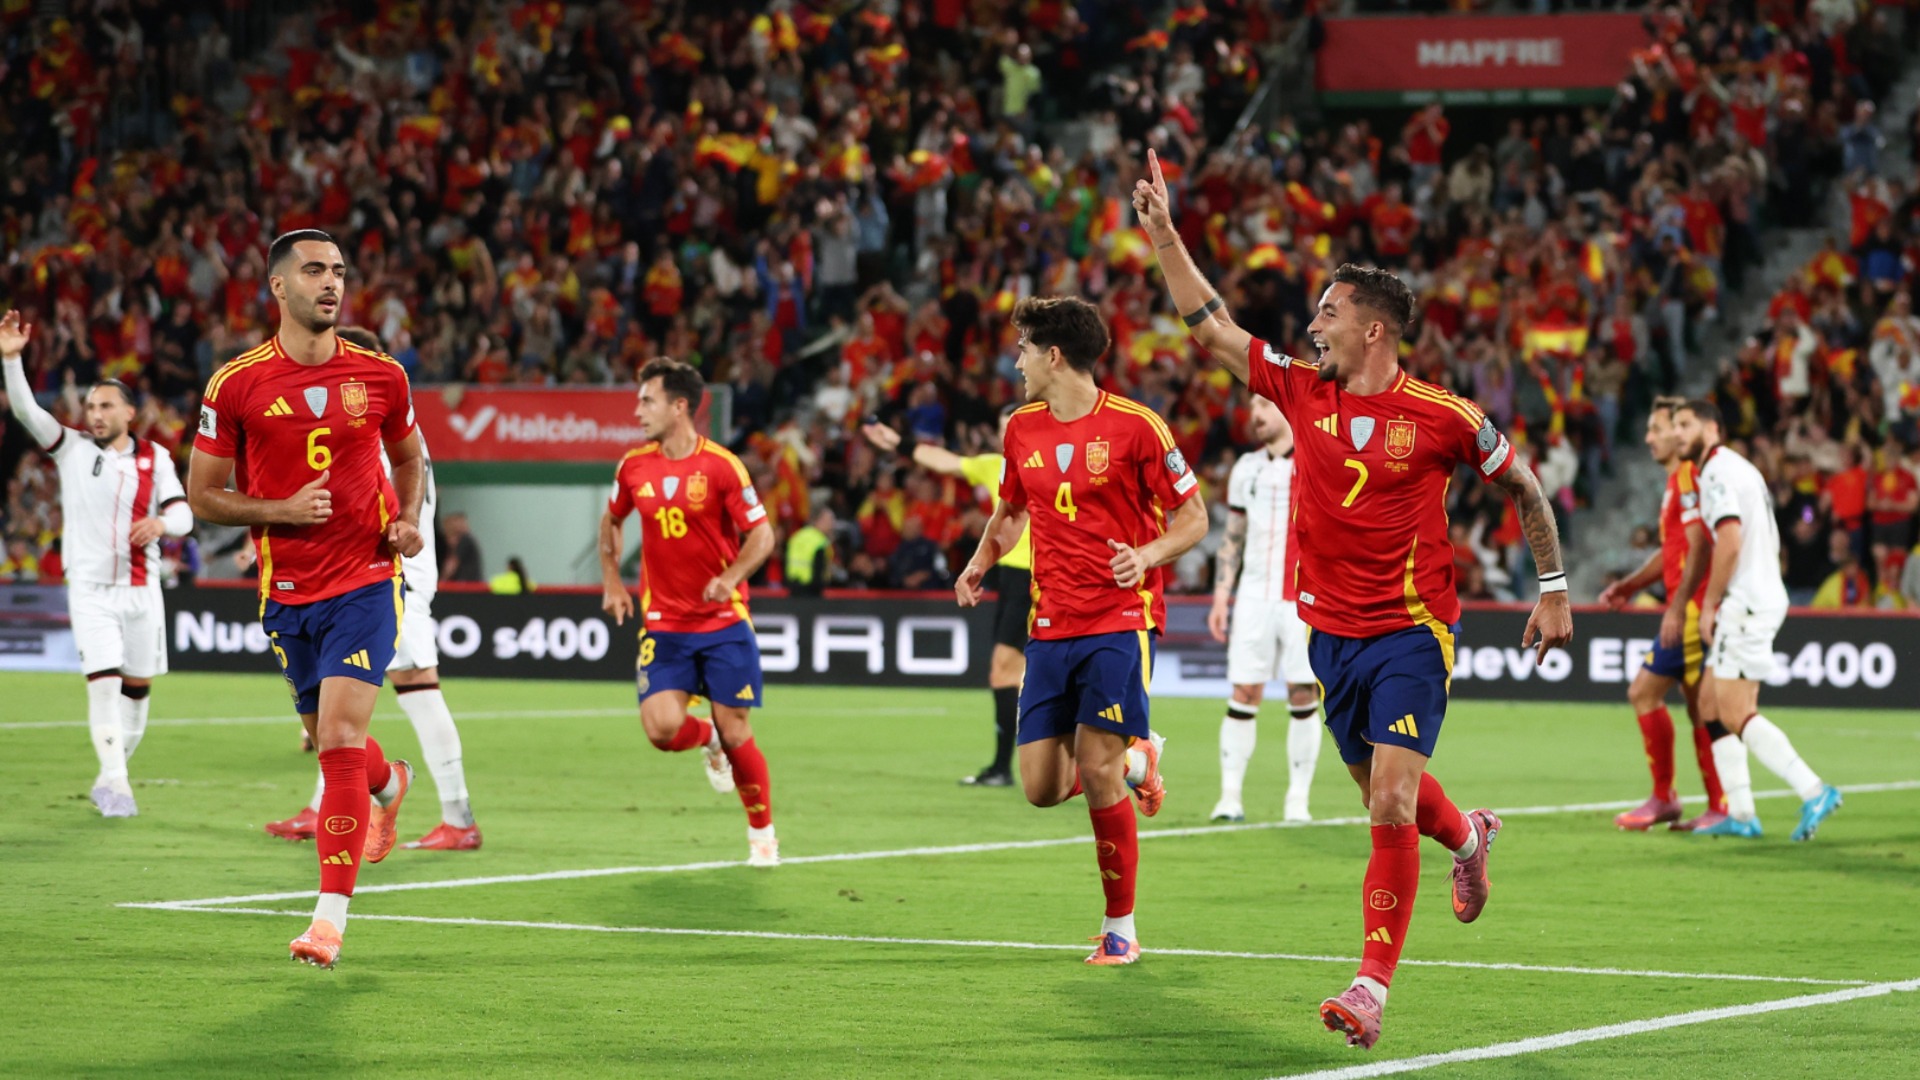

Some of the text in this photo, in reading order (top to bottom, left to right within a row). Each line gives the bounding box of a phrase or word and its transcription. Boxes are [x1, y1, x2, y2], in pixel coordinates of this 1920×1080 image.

[1417, 39, 1563, 67] MAPFRE
[497, 413, 598, 442] Halcón
[92, 455, 104, 477] 6
[307, 427, 333, 471] 6
[1054, 481, 1078, 522] 4
[1341, 458, 1369, 508] 7
[654, 506, 688, 540] 18
[175, 611, 271, 653] Nue
[492, 616, 610, 661] s400
[757, 614, 969, 675] BRO
[1452, 645, 1574, 682] uevo
